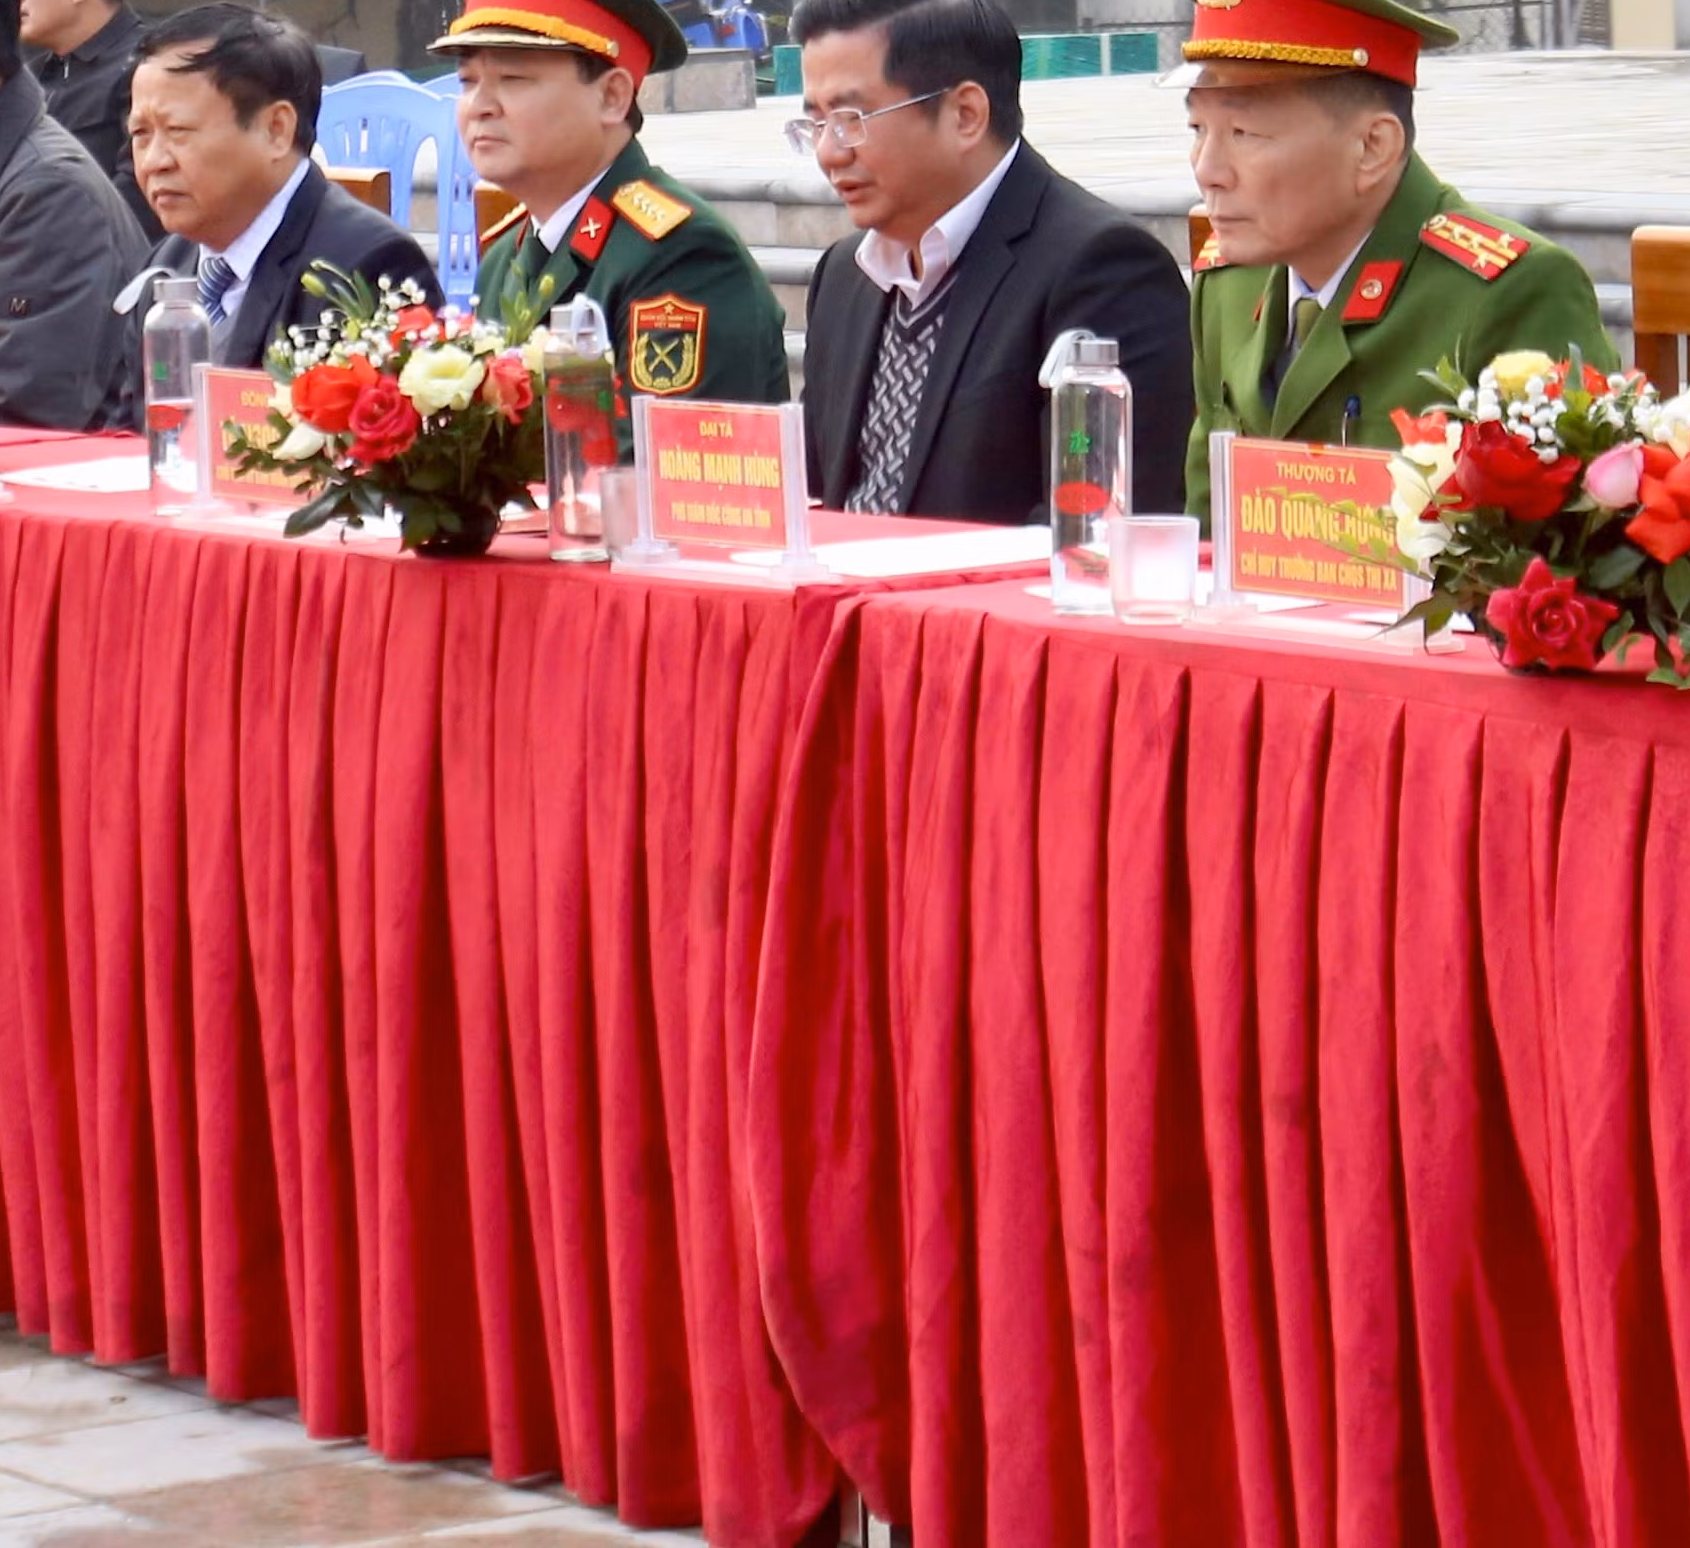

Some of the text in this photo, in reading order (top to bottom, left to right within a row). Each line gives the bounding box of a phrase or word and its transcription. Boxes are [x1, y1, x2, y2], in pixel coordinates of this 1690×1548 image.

[1276, 462, 1357, 485] THƯỢNG TÁ
[1240, 487, 1278, 536] ĐÀO
